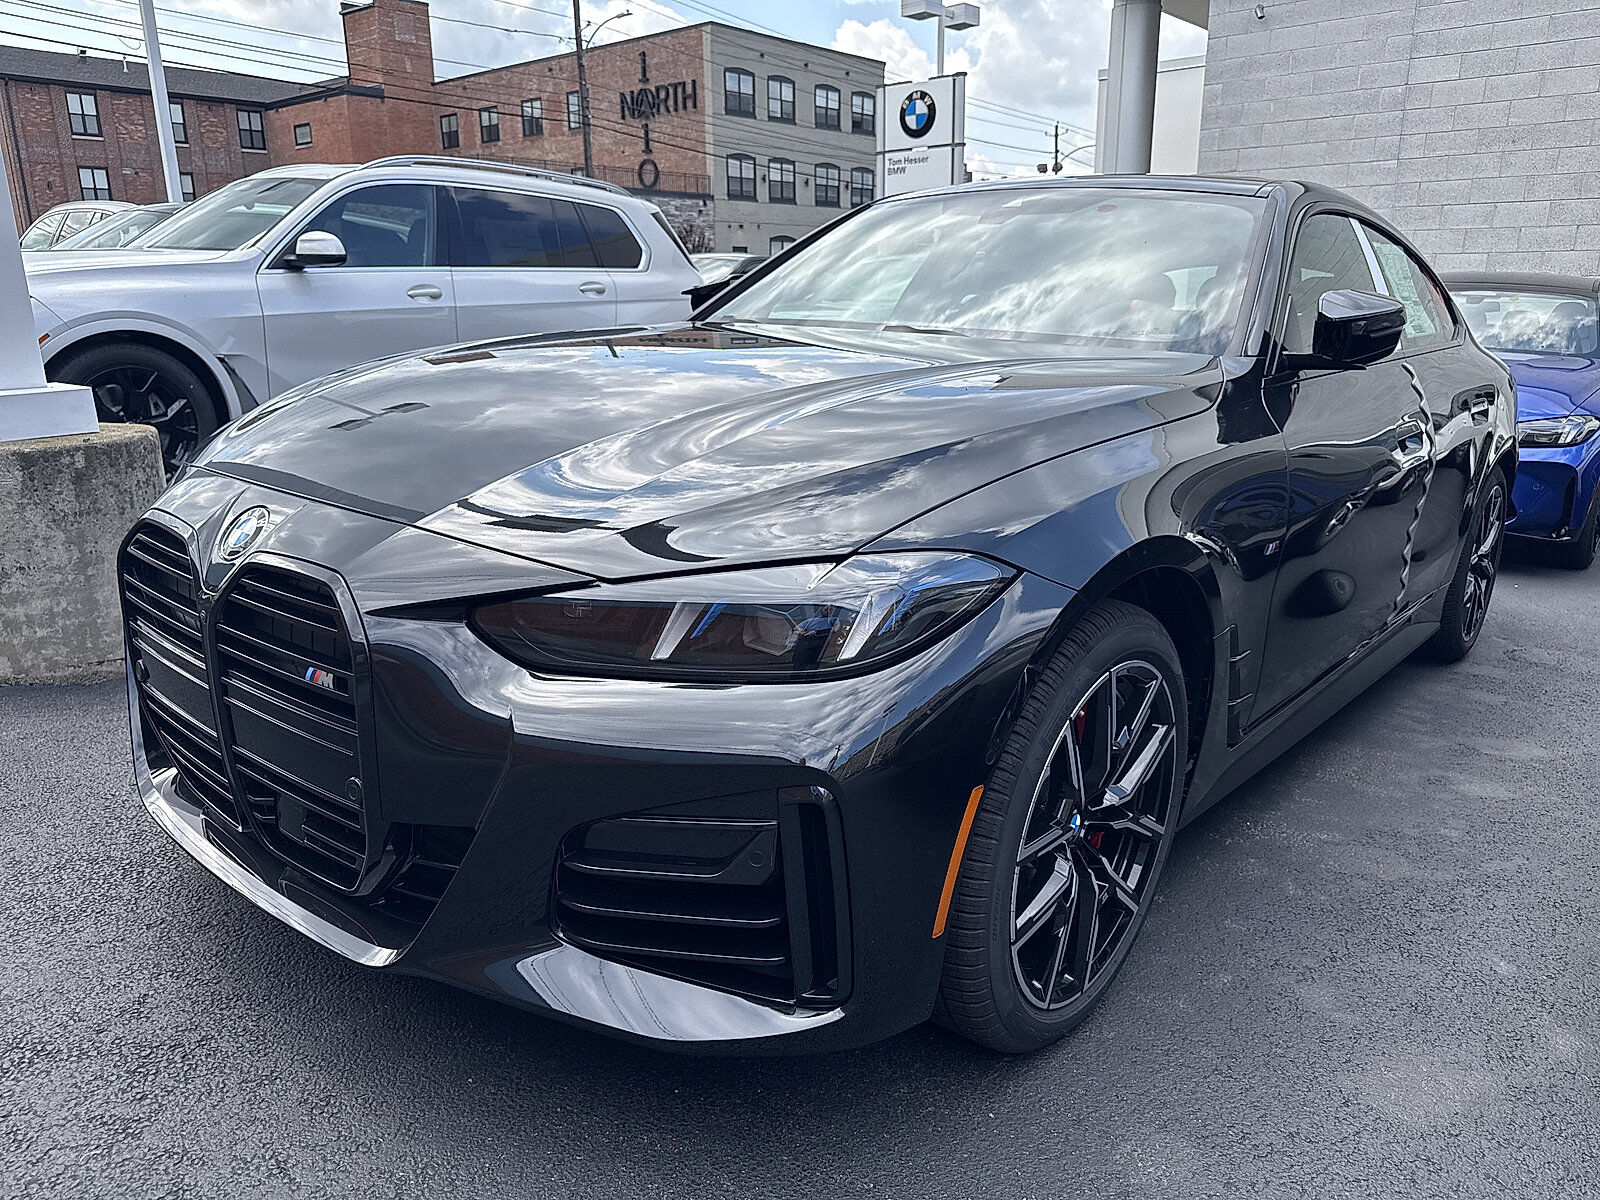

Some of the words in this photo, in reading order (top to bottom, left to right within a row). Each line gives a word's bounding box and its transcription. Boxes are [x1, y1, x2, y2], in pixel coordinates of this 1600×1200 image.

[619, 79, 697, 120] NORTH
[902, 91, 933, 109] BMW
[887, 158, 902, 167] Tom
[903, 156, 929, 165] Hesser
[887, 166, 907, 176] BMW
